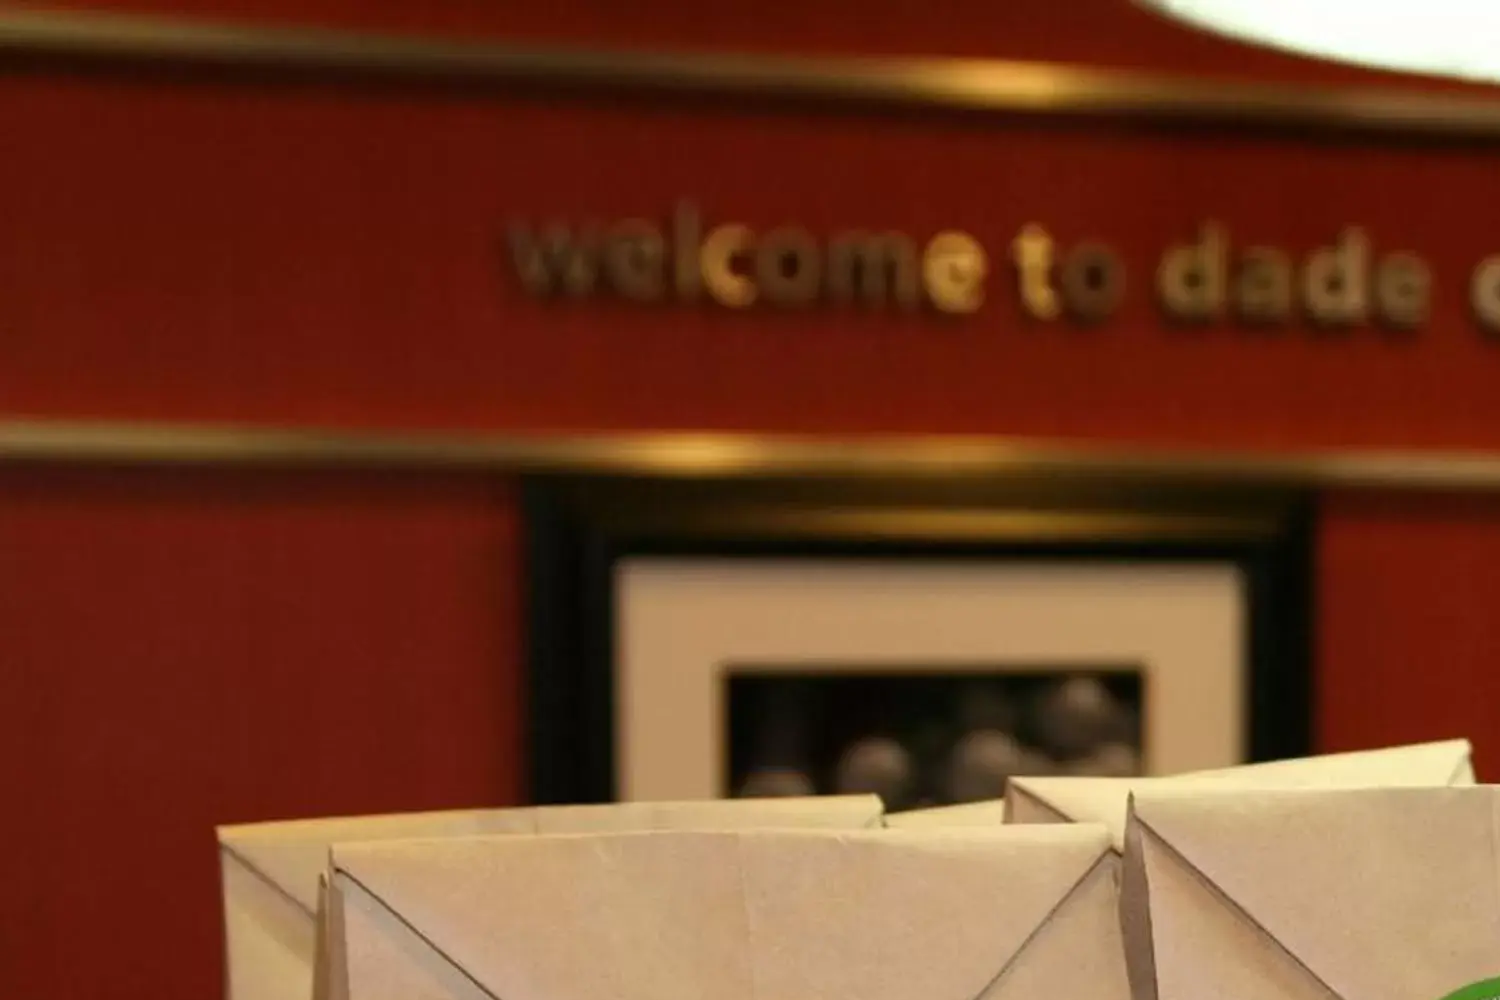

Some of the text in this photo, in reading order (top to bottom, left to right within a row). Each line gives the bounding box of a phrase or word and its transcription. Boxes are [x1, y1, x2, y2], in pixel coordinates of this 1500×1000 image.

[504, 198, 988, 314] welcome
[1012, 220, 1127, 325] to
[1157, 216, 1434, 330] dade
